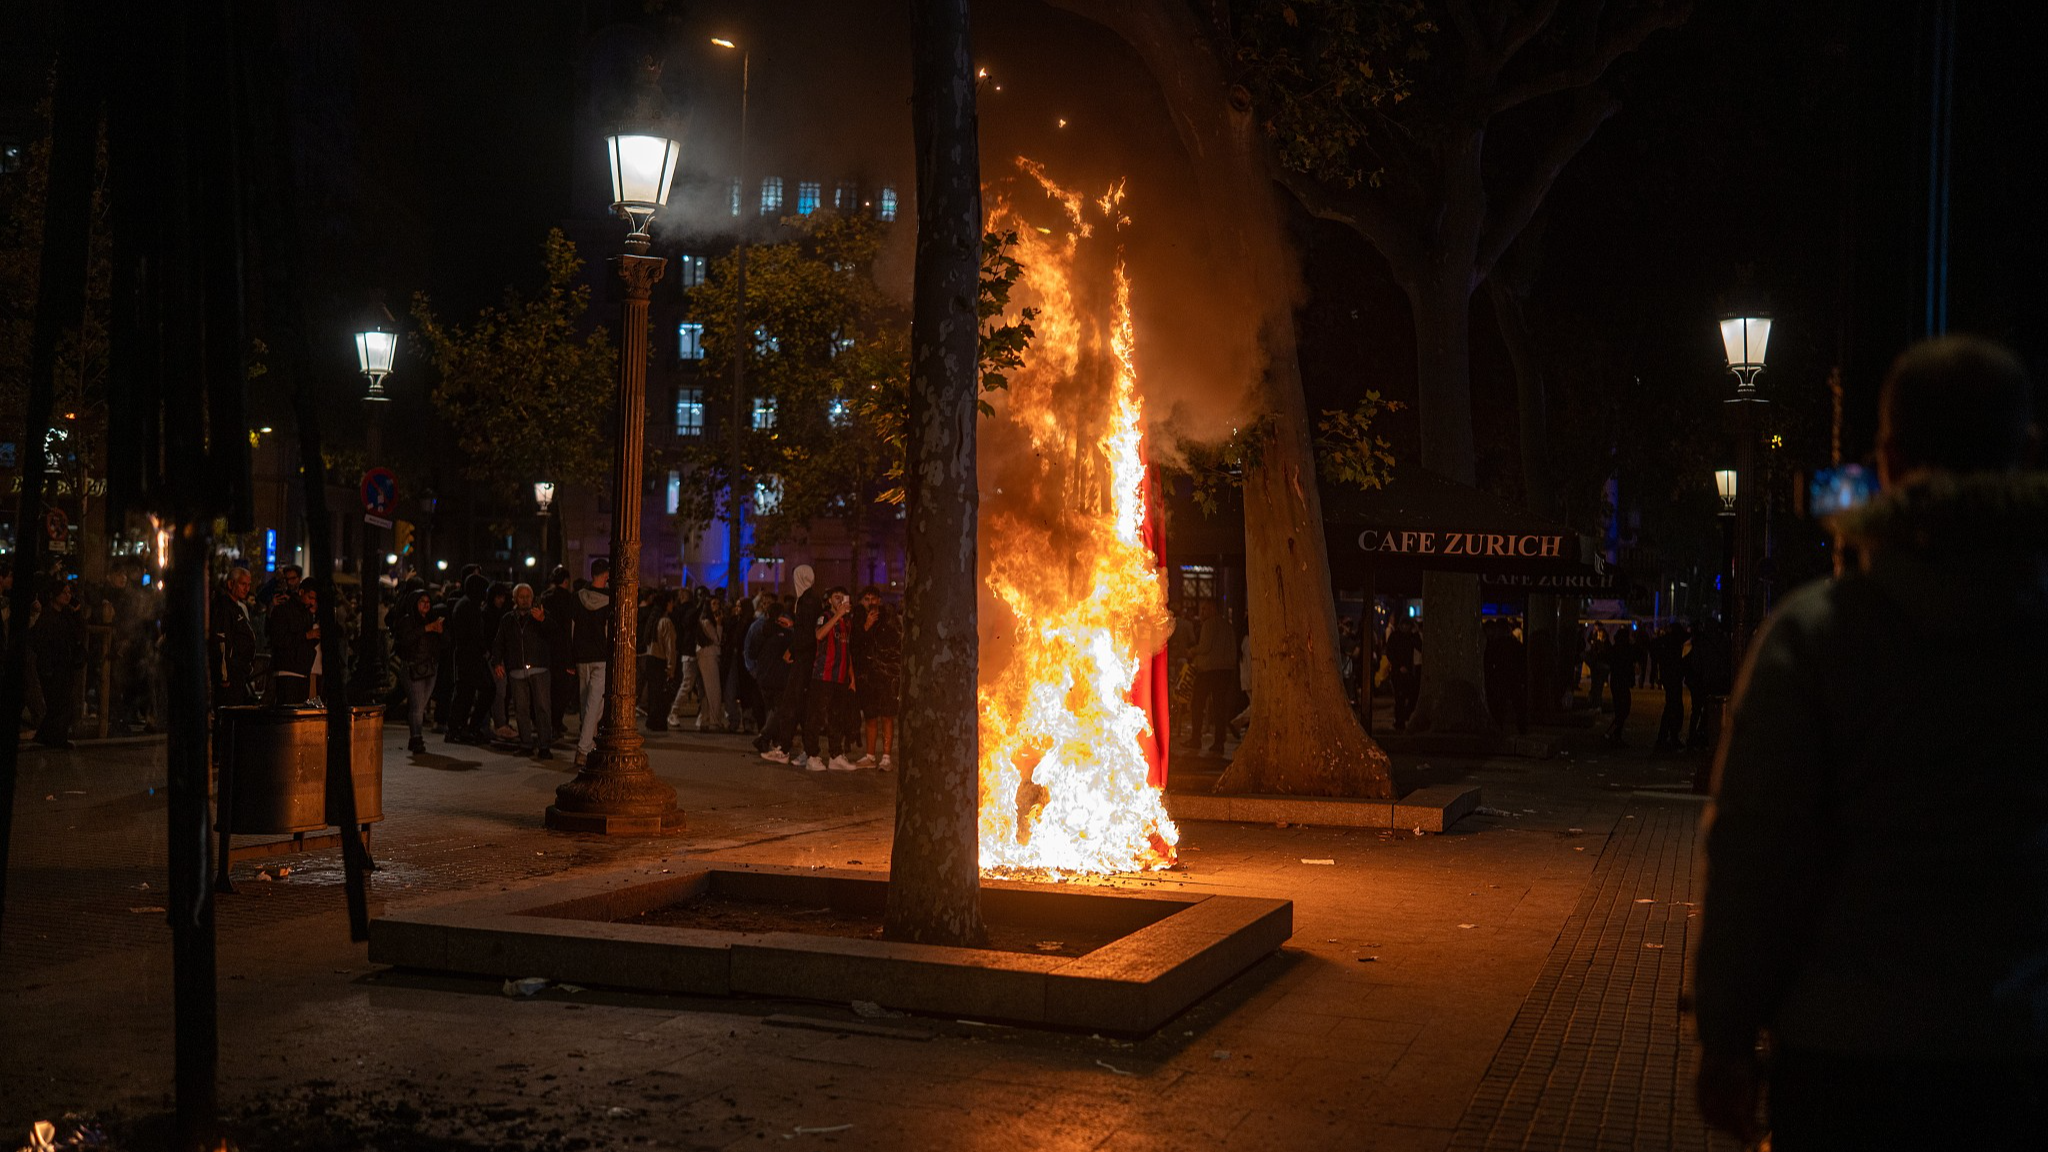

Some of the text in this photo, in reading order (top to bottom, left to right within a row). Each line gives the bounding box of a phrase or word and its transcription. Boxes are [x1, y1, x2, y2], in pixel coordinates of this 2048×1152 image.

[1358, 529, 1563, 557] CAFE ZURICH
[1482, 573, 1614, 588] CAFE ZURICH
